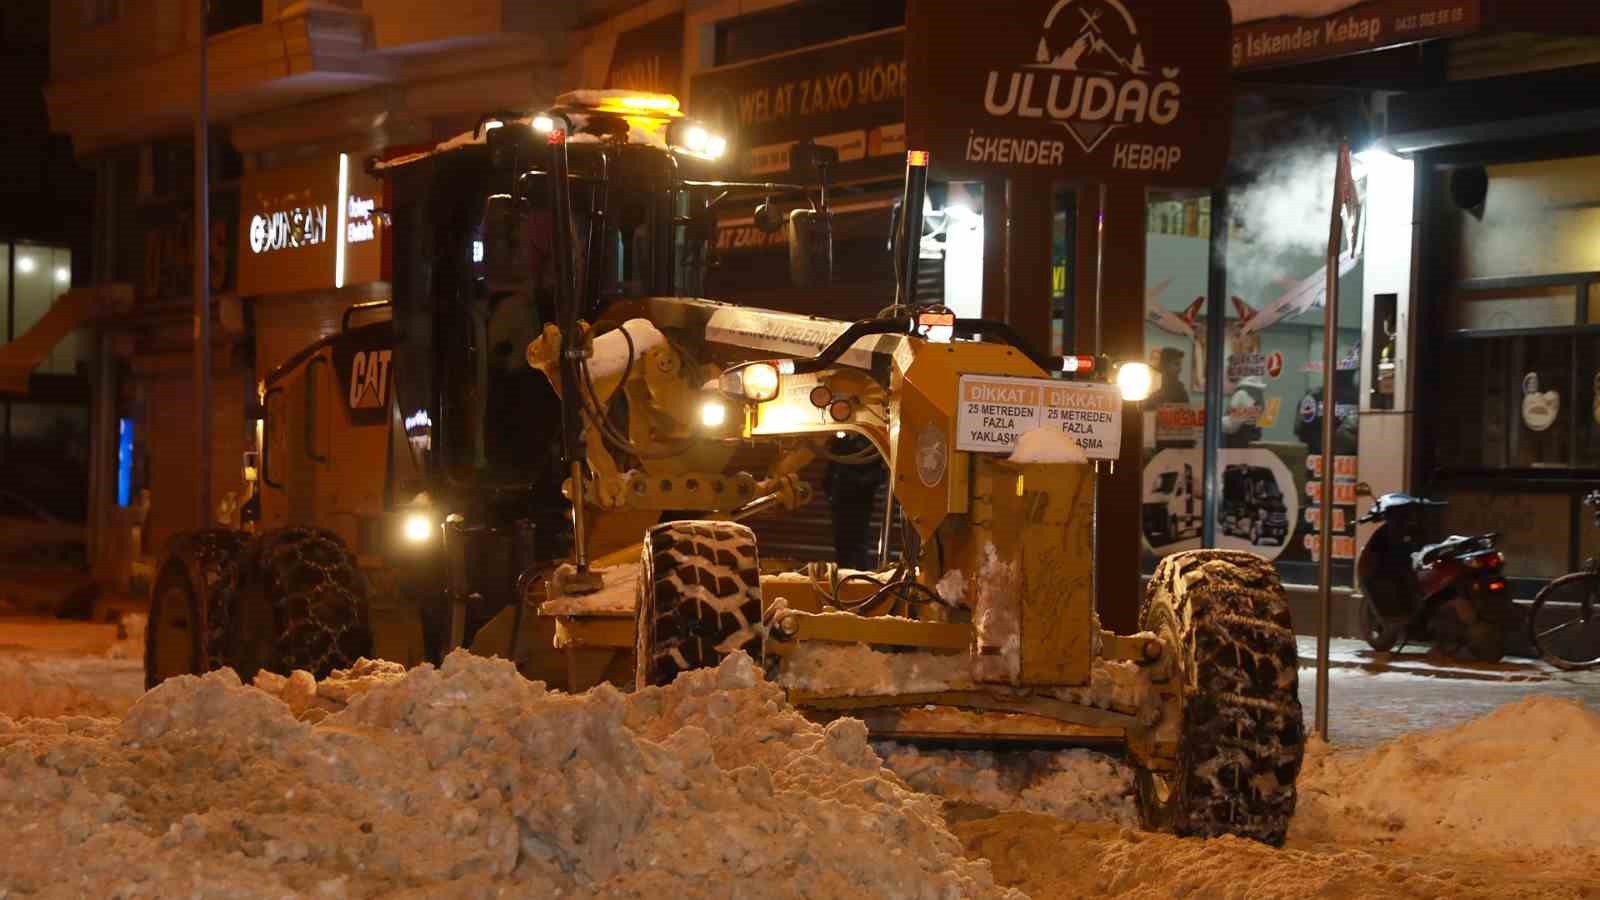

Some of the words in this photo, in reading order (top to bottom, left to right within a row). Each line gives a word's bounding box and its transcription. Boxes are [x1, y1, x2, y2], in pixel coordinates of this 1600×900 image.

[1325, 15, 1381, 42] Kebap
[801, 71, 853, 114] ZAXO
[984, 67, 1181, 124] ULUDAĞ
[965, 129, 1065, 165] İSKENDER
[1112, 144, 1182, 171] KEBAP
[350, 350, 392, 408] CAT
[971, 384, 1025, 402] DİKKAT
[1051, 389, 1105, 407] DİKKAT
[968, 404, 979, 415] 25
[981, 405, 1034, 417] METREDEN
[1048, 409, 1058, 419] 25
[1061, 410, 1112, 423] METREDEN
[983, 417, 1015, 428] FAZLA
[1062, 422, 1094, 434] FAZLA
[970, 431, 1020, 445] YAKLAŞM
[1075, 437, 1103, 451] AŞMA
